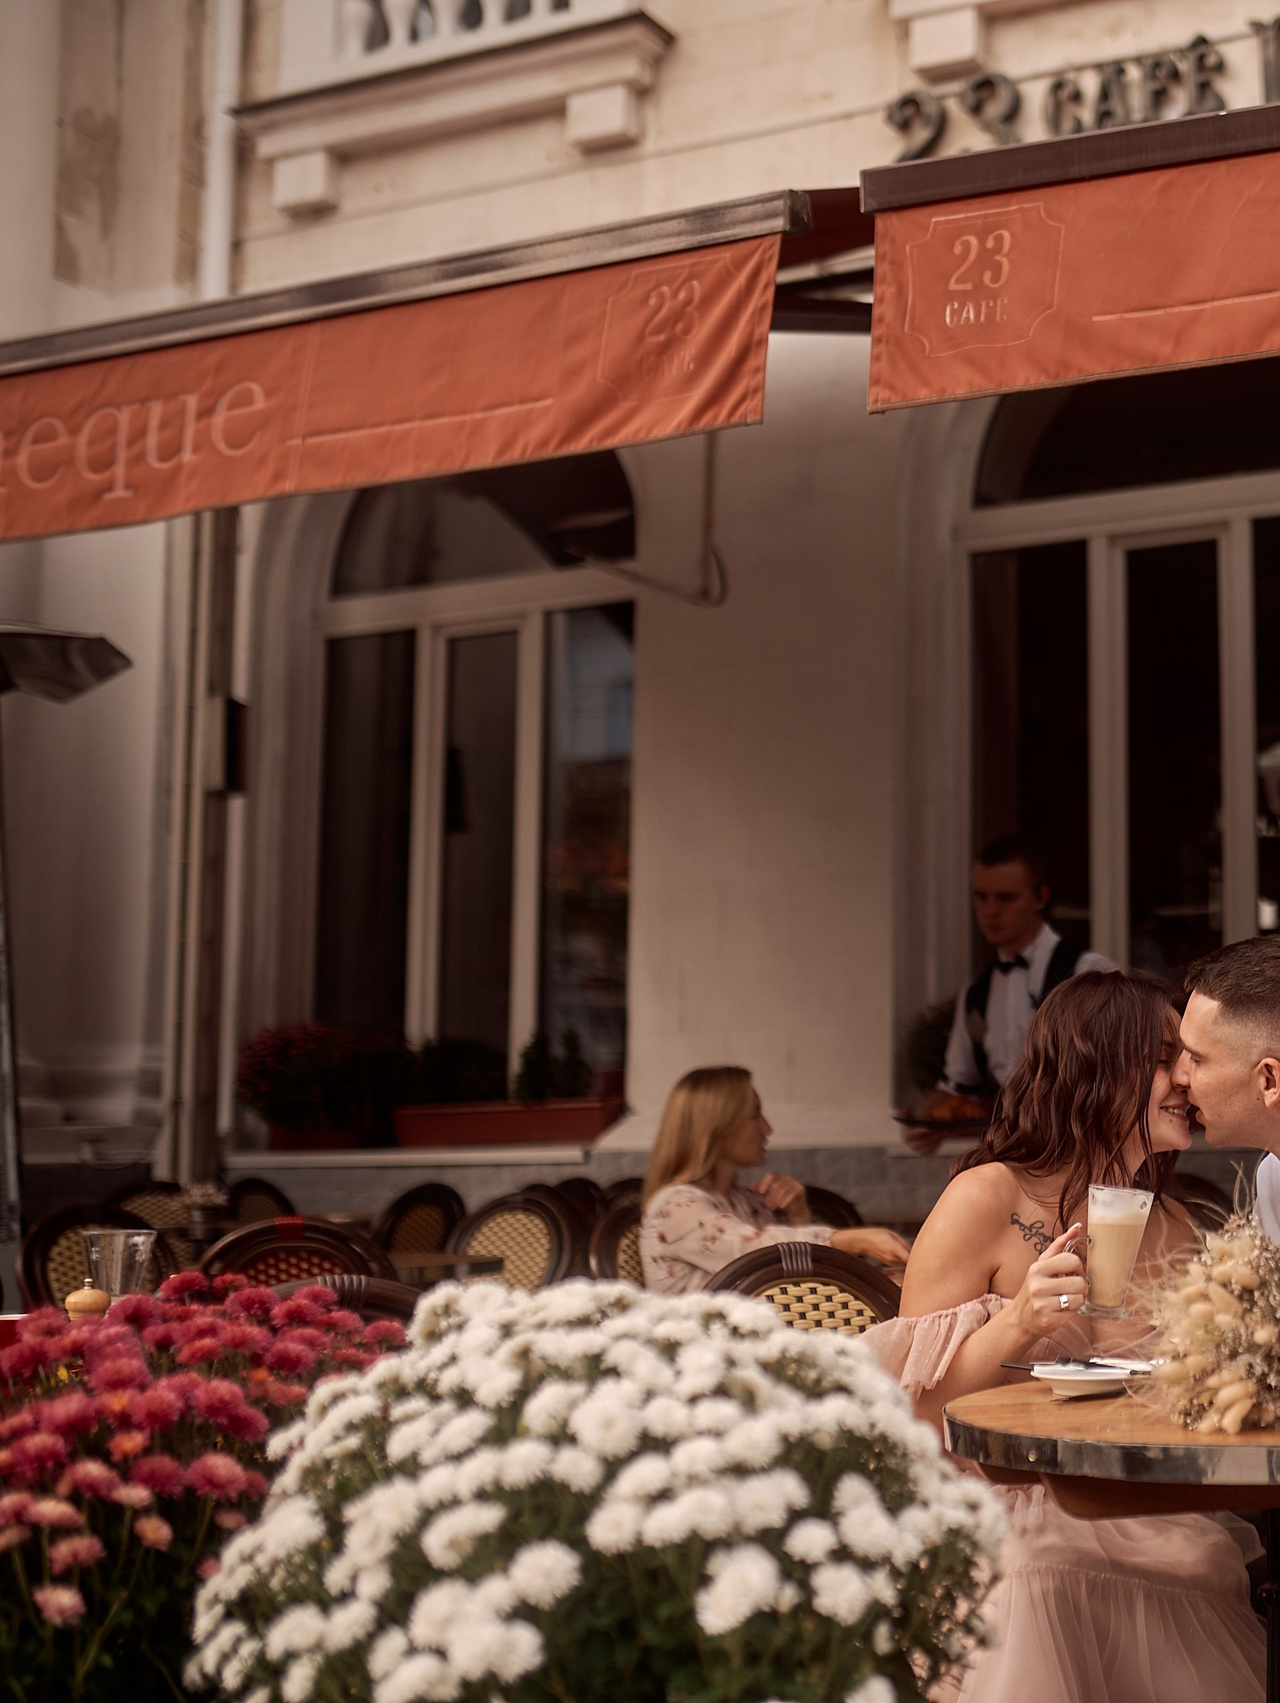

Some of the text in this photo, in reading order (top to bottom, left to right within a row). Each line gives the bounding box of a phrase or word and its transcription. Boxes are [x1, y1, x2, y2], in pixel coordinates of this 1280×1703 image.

[948, 229, 1012, 291] 23
[643, 280, 701, 343] 23
[0, 380, 266, 500] eque
